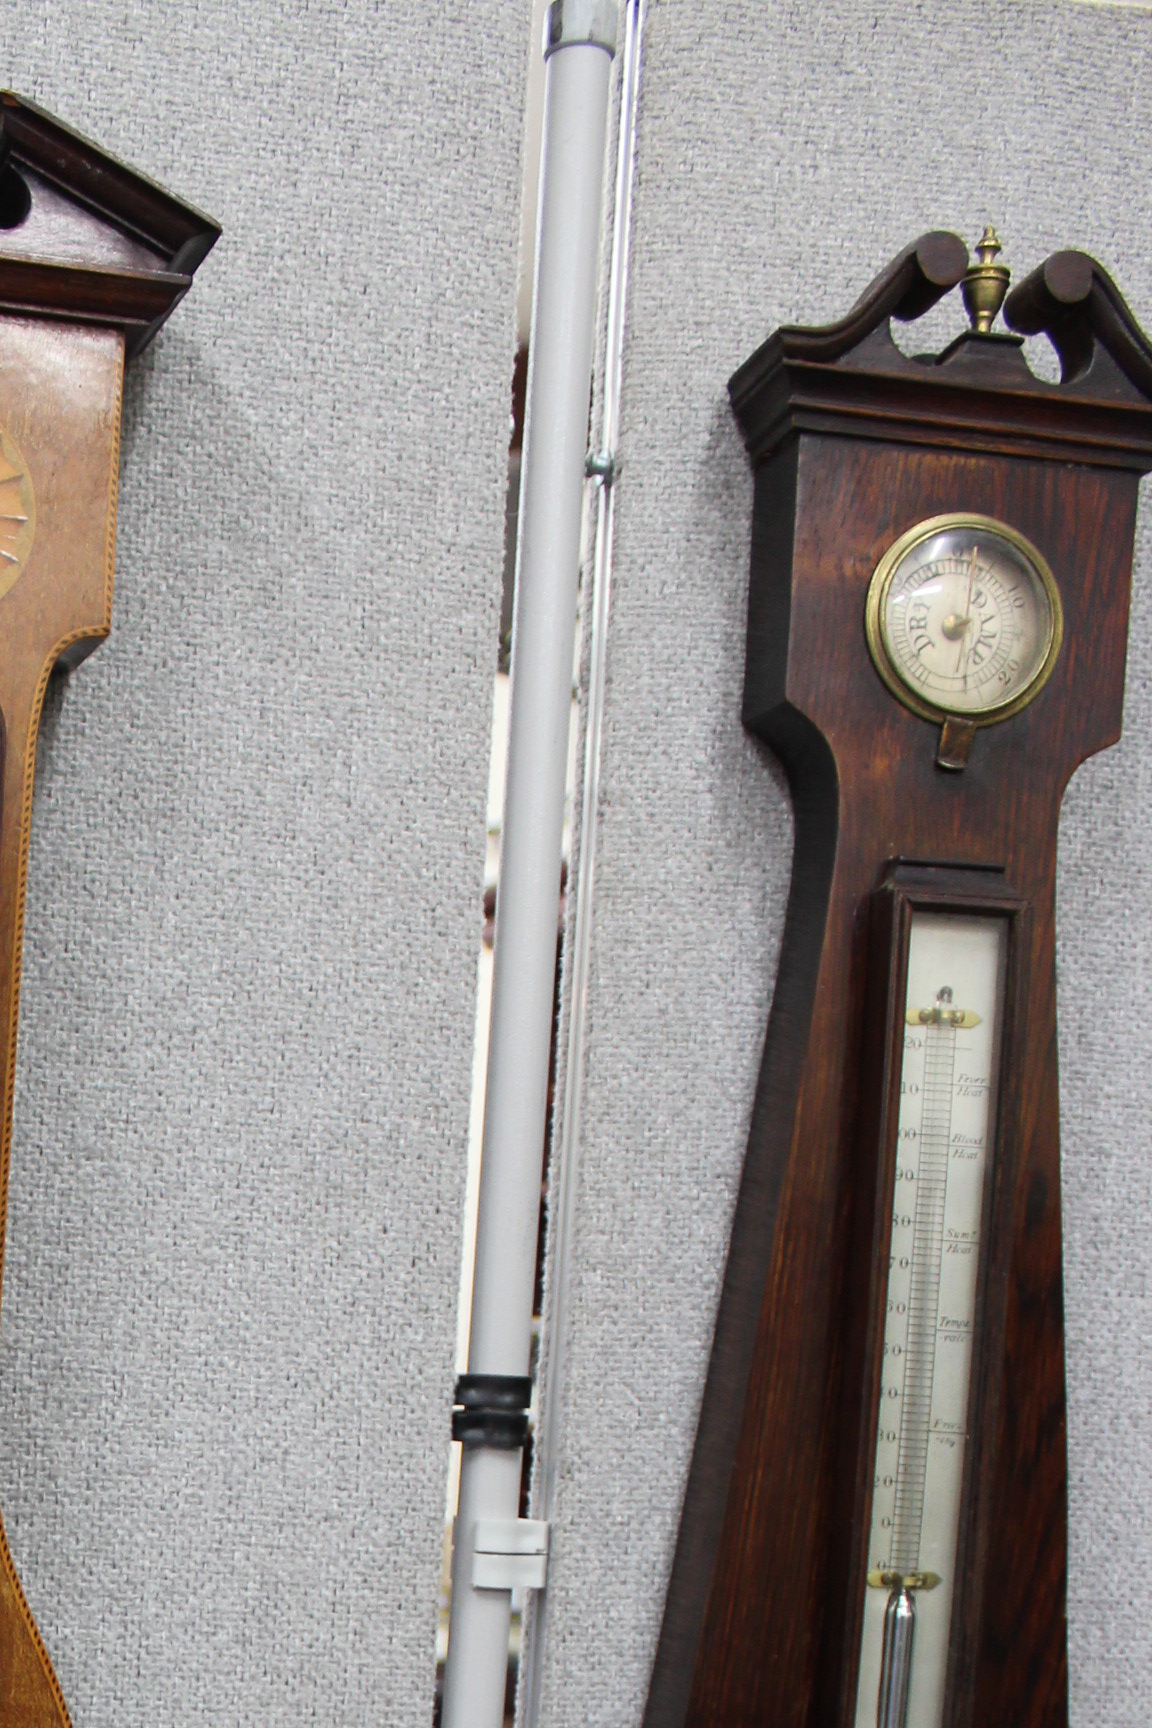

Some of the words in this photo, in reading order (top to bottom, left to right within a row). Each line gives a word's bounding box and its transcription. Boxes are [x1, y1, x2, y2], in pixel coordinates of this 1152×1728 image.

[909, 601, 936, 657] DRY
[971, 589, 998, 666] DAMP
[998, 658, 1020, 686] 20
